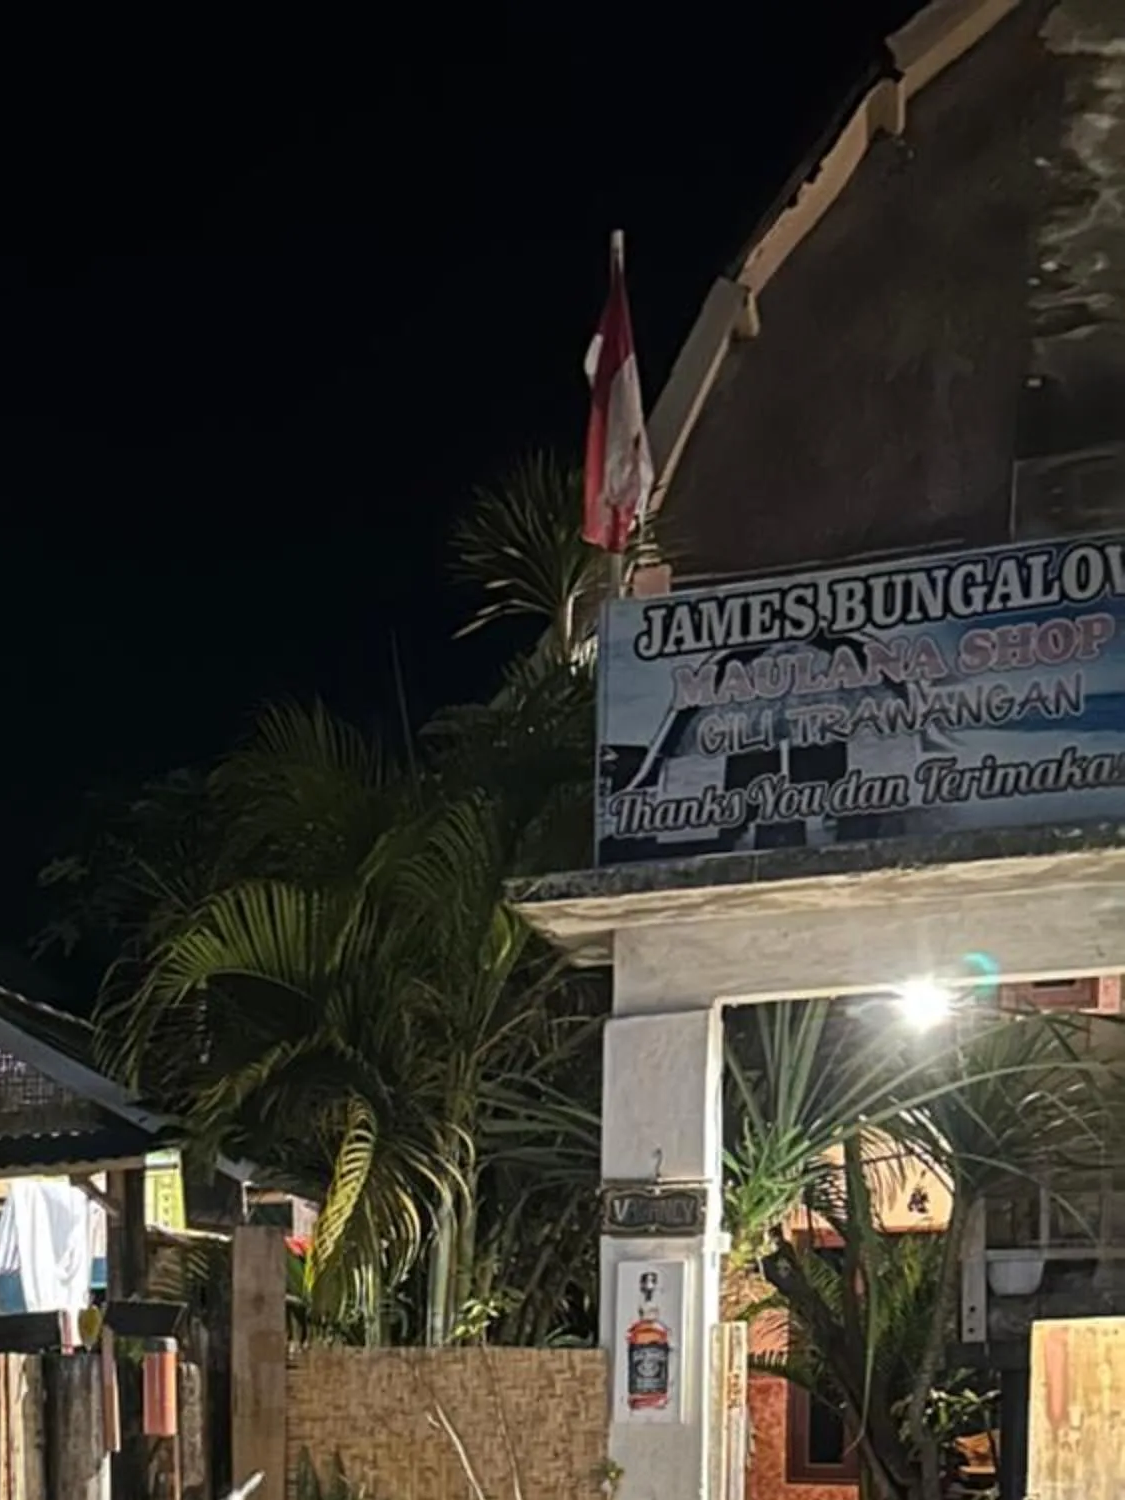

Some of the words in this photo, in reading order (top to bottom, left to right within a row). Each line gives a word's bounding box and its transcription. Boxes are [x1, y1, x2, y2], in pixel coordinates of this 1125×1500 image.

[636, 584, 817, 660] JAMES
[675, 636, 948, 709] MAULANA
[959, 613, 1115, 674] SHOP
[697, 710, 775, 756] GILI
[785, 670, 1085, 747] TRAWANGAN
[610, 784, 744, 836] Thanks
[747, 773, 827, 823] You
[828, 769, 908, 815] dan
